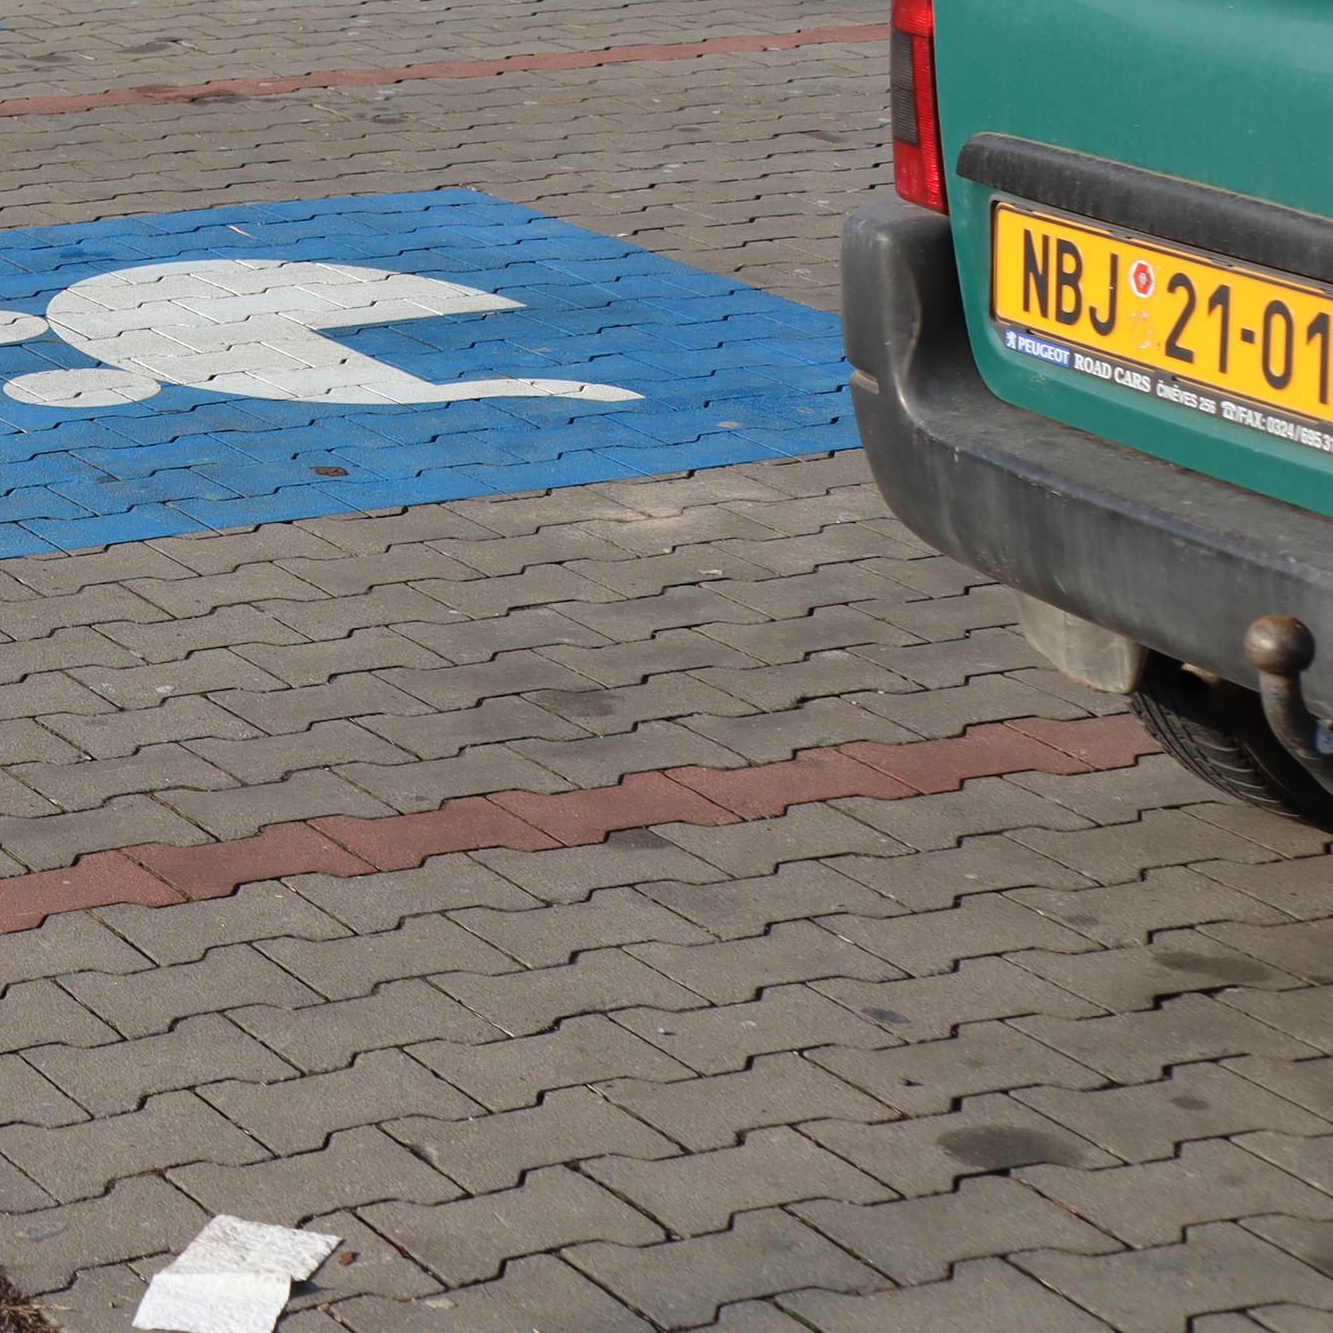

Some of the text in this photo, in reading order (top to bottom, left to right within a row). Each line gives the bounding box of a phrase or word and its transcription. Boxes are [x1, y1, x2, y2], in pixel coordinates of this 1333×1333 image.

[1017, 336, 1070, 365] PEUGEOT
[1073, 353, 1112, 380] ROAD
[1114, 367, 1151, 393] CARS
[1022, 227, 1332, 406] NBJ 21-01
